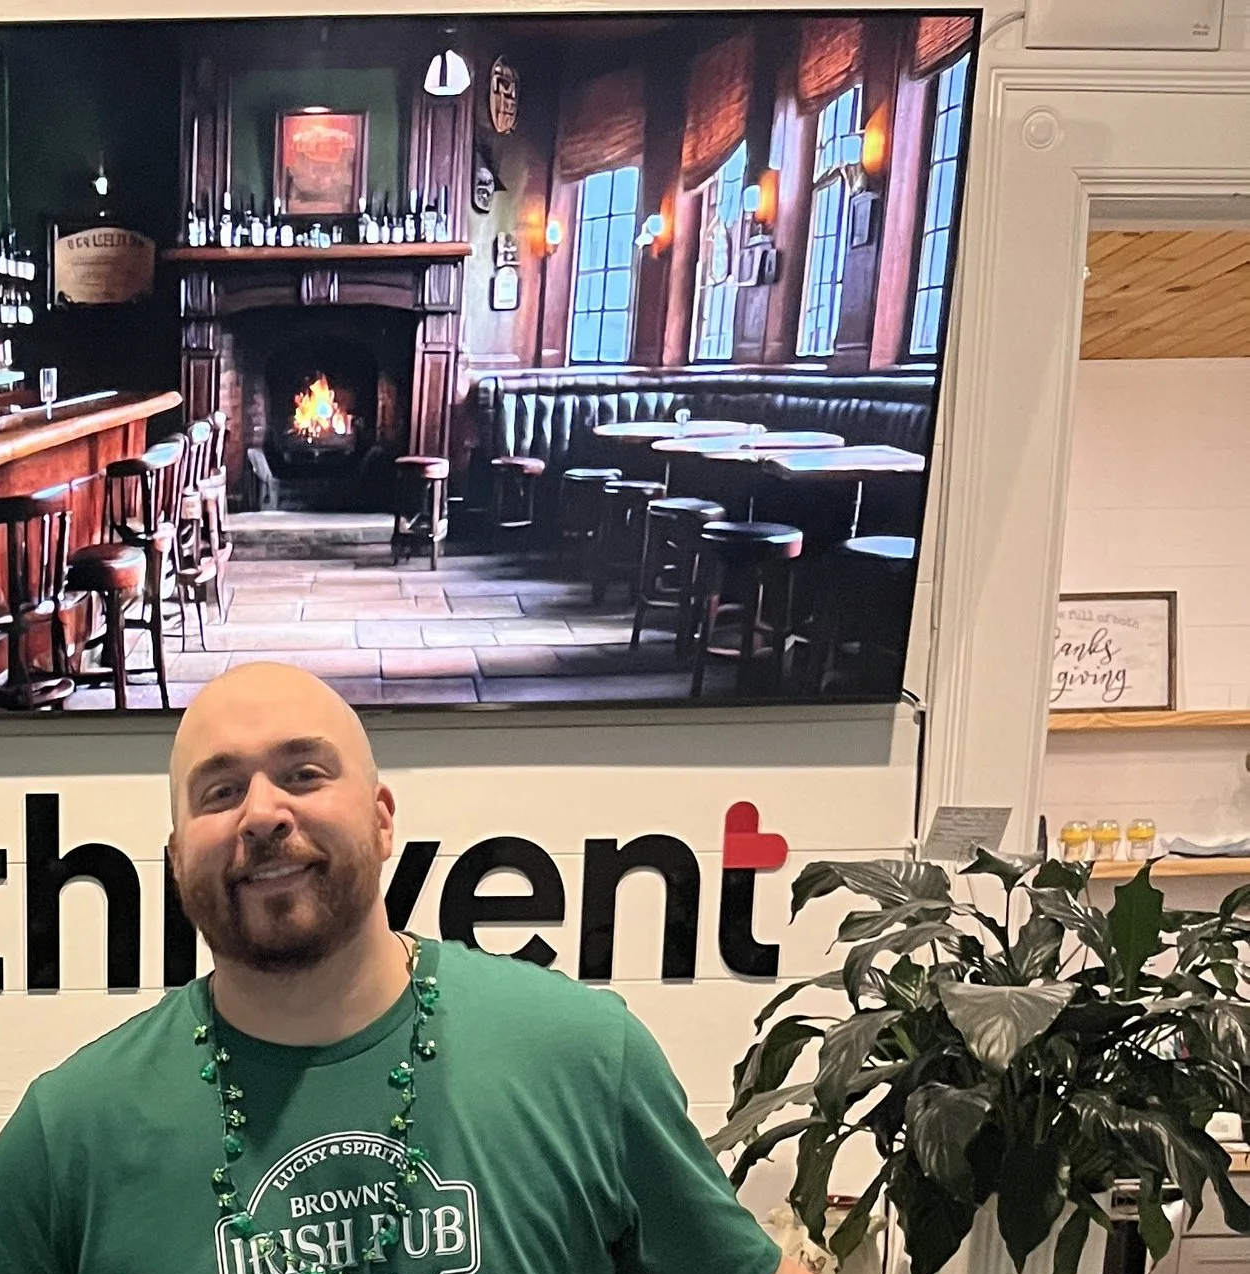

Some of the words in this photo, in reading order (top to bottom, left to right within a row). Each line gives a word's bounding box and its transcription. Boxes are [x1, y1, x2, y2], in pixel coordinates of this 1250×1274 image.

[1054, 628, 1121, 665] anks
[1050, 666, 1132, 703] giving
[272, 1147, 328, 1191] LUCKY
[342, 1141, 409, 1173] SPIRITS
[289, 1181, 398, 1218] BROWN'S
[368, 1205, 467, 1264] PUB
